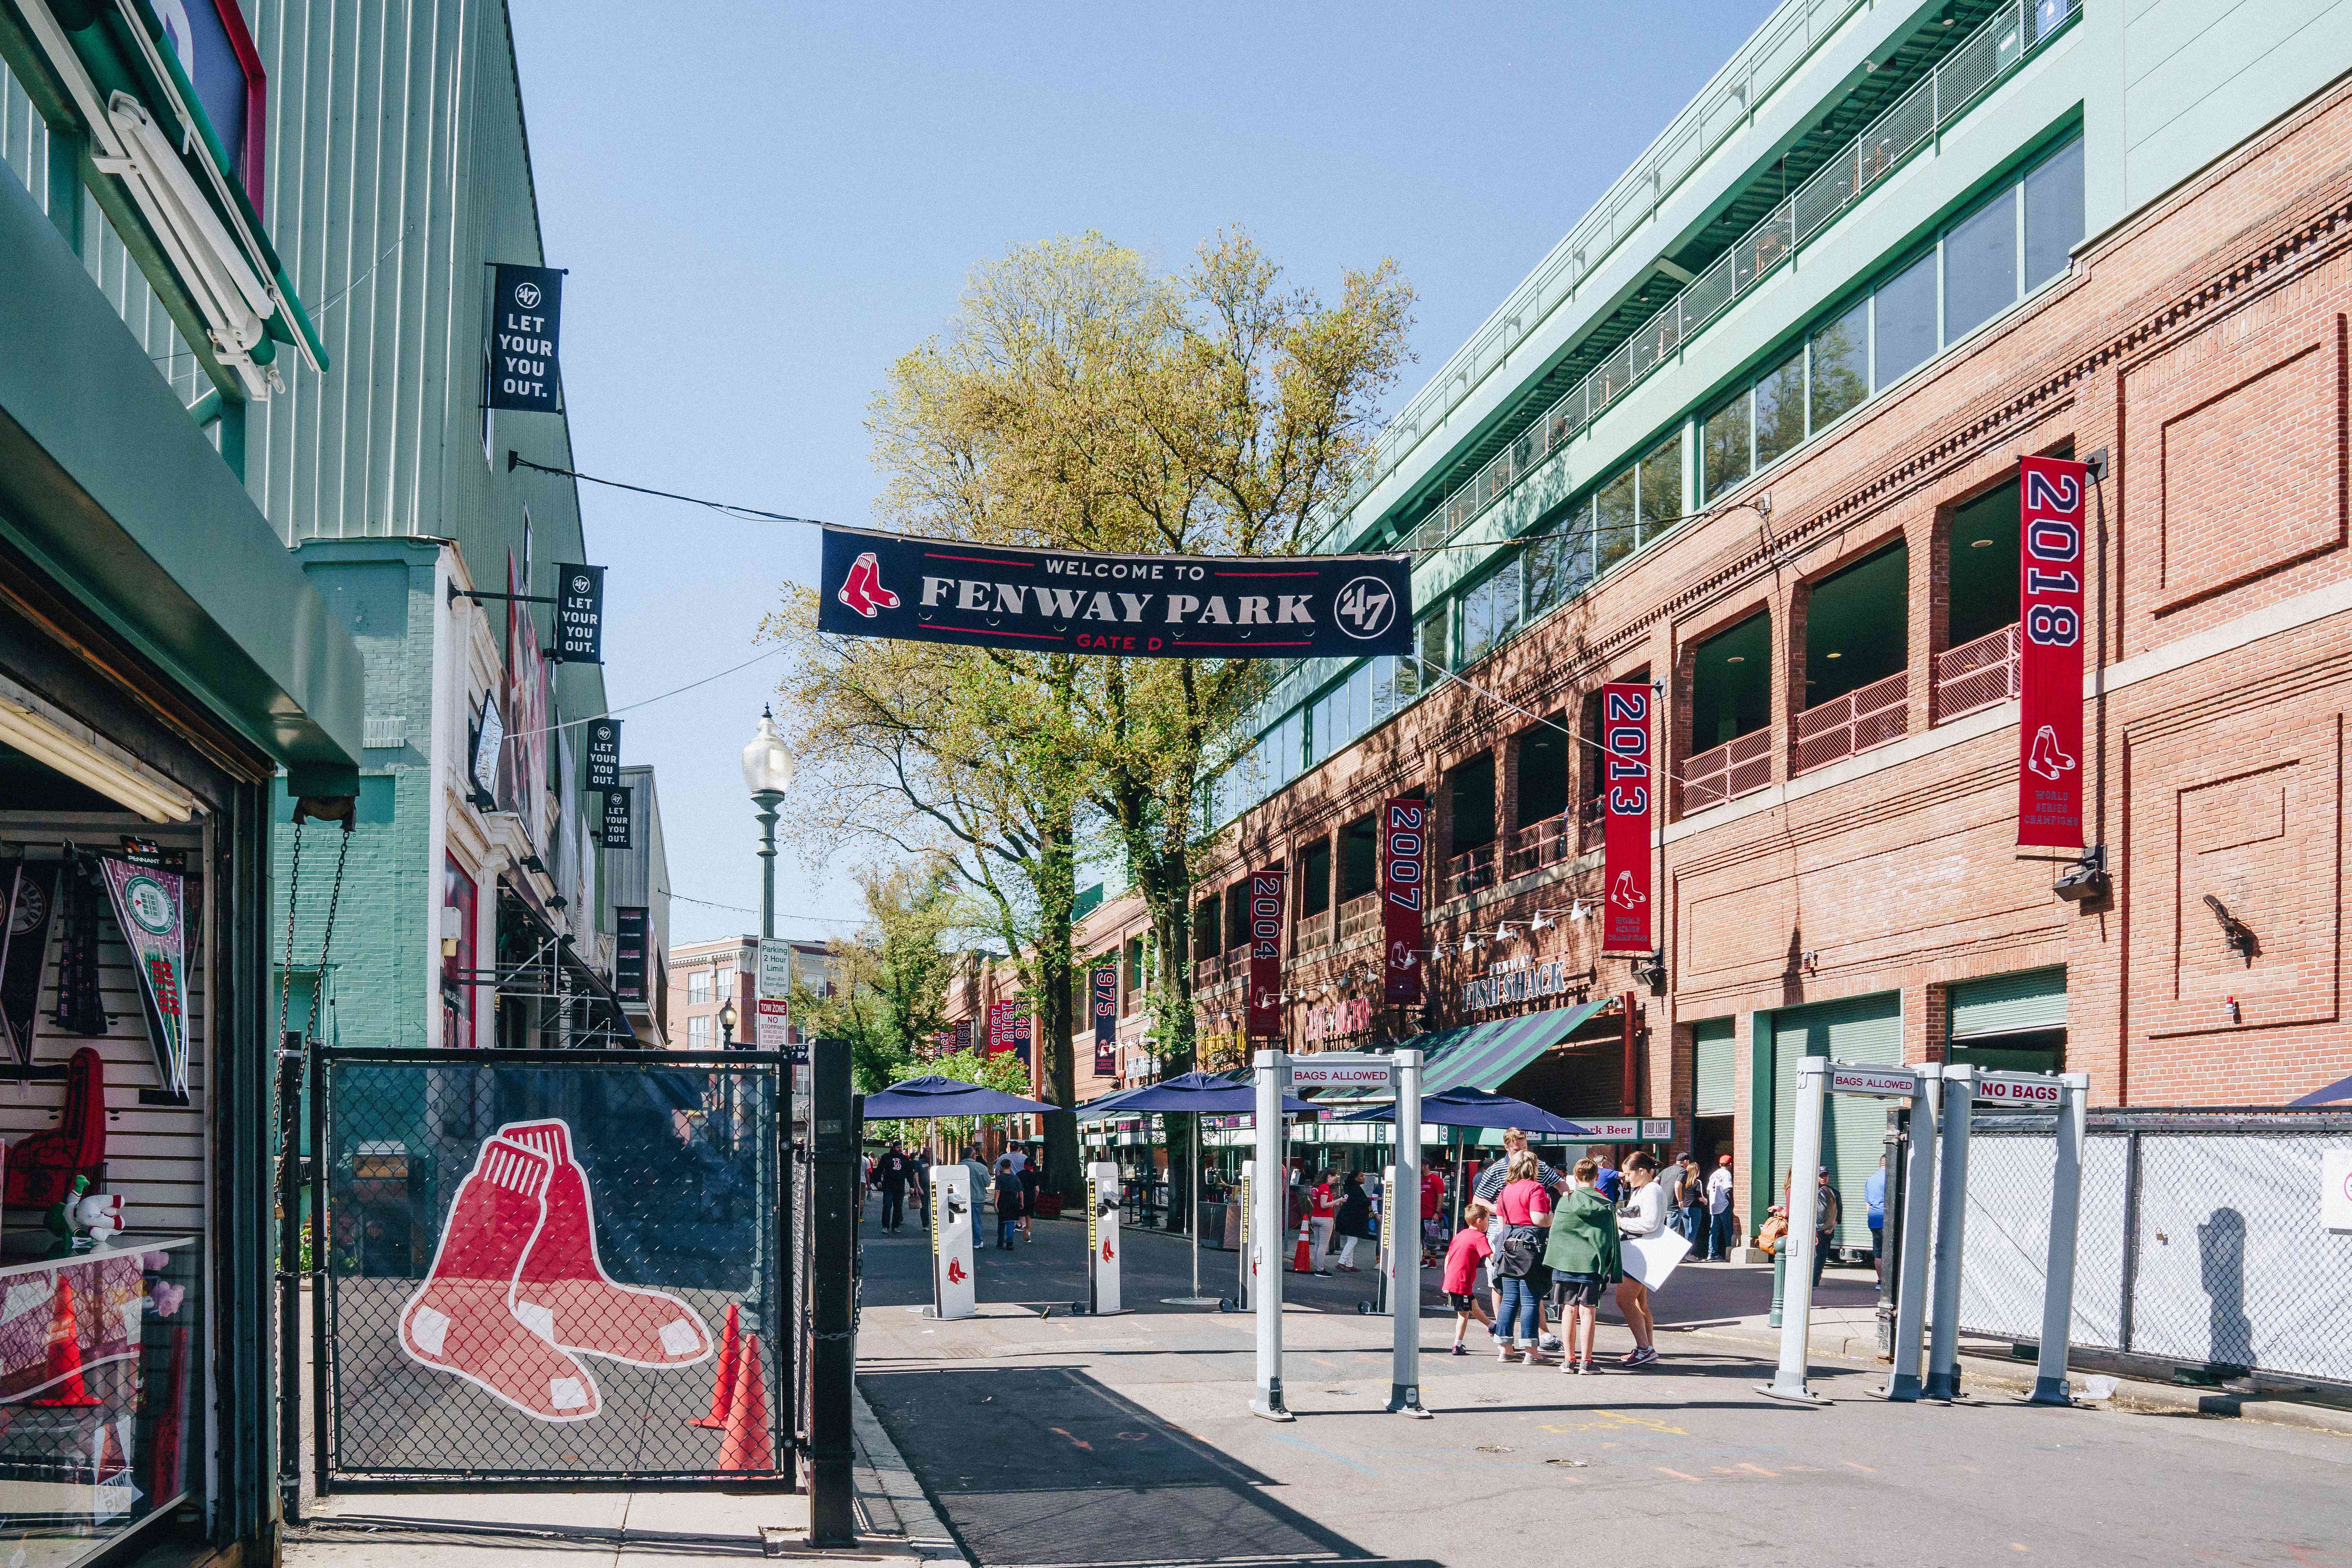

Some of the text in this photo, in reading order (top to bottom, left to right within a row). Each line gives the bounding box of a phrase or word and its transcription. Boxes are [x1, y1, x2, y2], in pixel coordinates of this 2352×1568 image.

[508, 314, 544, 333] LET
[499, 334, 552, 357] YOUR
[505, 357, 544, 377] YOU
[504, 379, 547, 397] OUT.
[2027, 469, 2080, 647] 2018
[1046, 559, 1205, 581] WELCOME TO
[568, 597, 592, 609] LET
[920, 576, 1315, 624] FENWAY PARK
[562, 612, 598, 624] YOUR
[566, 626, 593, 639] YOU
[565, 641, 595, 653] OUT.
[1076, 633, 1162, 650] GATE D
[594, 743, 613, 752] LET
[1609, 693, 1648, 816] 2013
[590, 753, 617, 764] YOUR
[593, 765, 613, 774] YOU
[593, 776, 615, 784] OUT.
[2035, 789, 2069, 801] WORLD
[2035, 802, 2068, 813] SERIES
[2024, 813, 2080, 826] CHAMPIONS
[128, 855, 160, 864] PENNANT
[1390, 806, 1421, 911] 2007
[157, 886, 174, 929] FENWAY PARK
[1254, 877, 1279, 960] 2004
[1607, 934, 1648, 942] CHAMPIONS
[762, 945, 787, 955] Parking
[1489, 955, 1534, 976] FENWAY
[151, 960, 170, 1013] RED SOX
[162, 962, 181, 1015] BOSTON
[1097, 964, 1115, 1016] 1975
[1462, 975, 1501, 1012] FISH
[1502, 960, 1566, 1003] SHACK
[760, 1003, 785, 1013] TOW ZONE
[1002, 1004, 1014, 1042] 1918
[1305, 1006, 1328, 1041] TASTE
[1336, 996, 1370, 1035] BOSTON
[1294, 1071, 1388, 1080] BAGS ALLOWED
[1835, 1076, 1913, 1090] BAGS ALLOWED
[1981, 1083, 2058, 1101] NO BAGS
[1585, 1125, 1632, 1134] rk Beer
[1645, 1122, 1669, 1134] BUD LIGHT
[892, 1158, 902, 1170] B
[1383, 1187, 1392, 1250] 1-800-PAVEMENT
